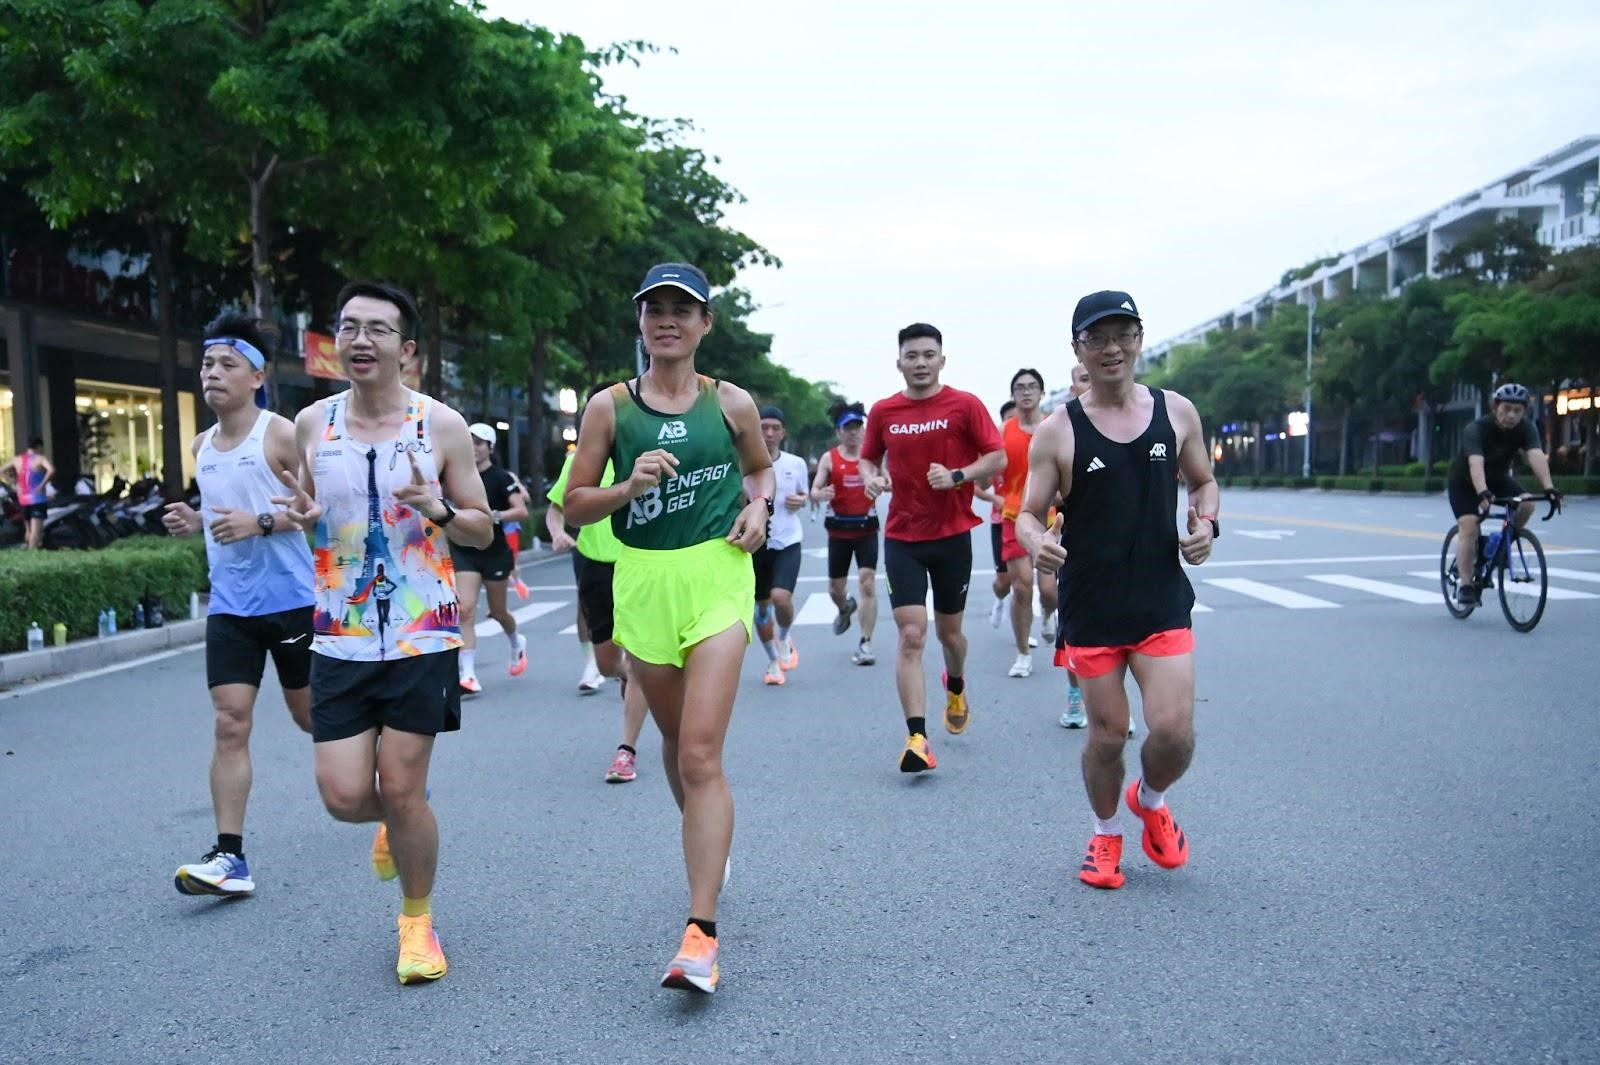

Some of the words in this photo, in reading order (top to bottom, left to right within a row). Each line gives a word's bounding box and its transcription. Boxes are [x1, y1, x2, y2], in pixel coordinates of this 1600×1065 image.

[657, 420, 688, 440] AB
[889, 419, 948, 434] GARMIN
[1149, 442, 1167, 457] AR
[666, 462, 732, 494] ENERGY
[666, 490, 696, 513] GEL
